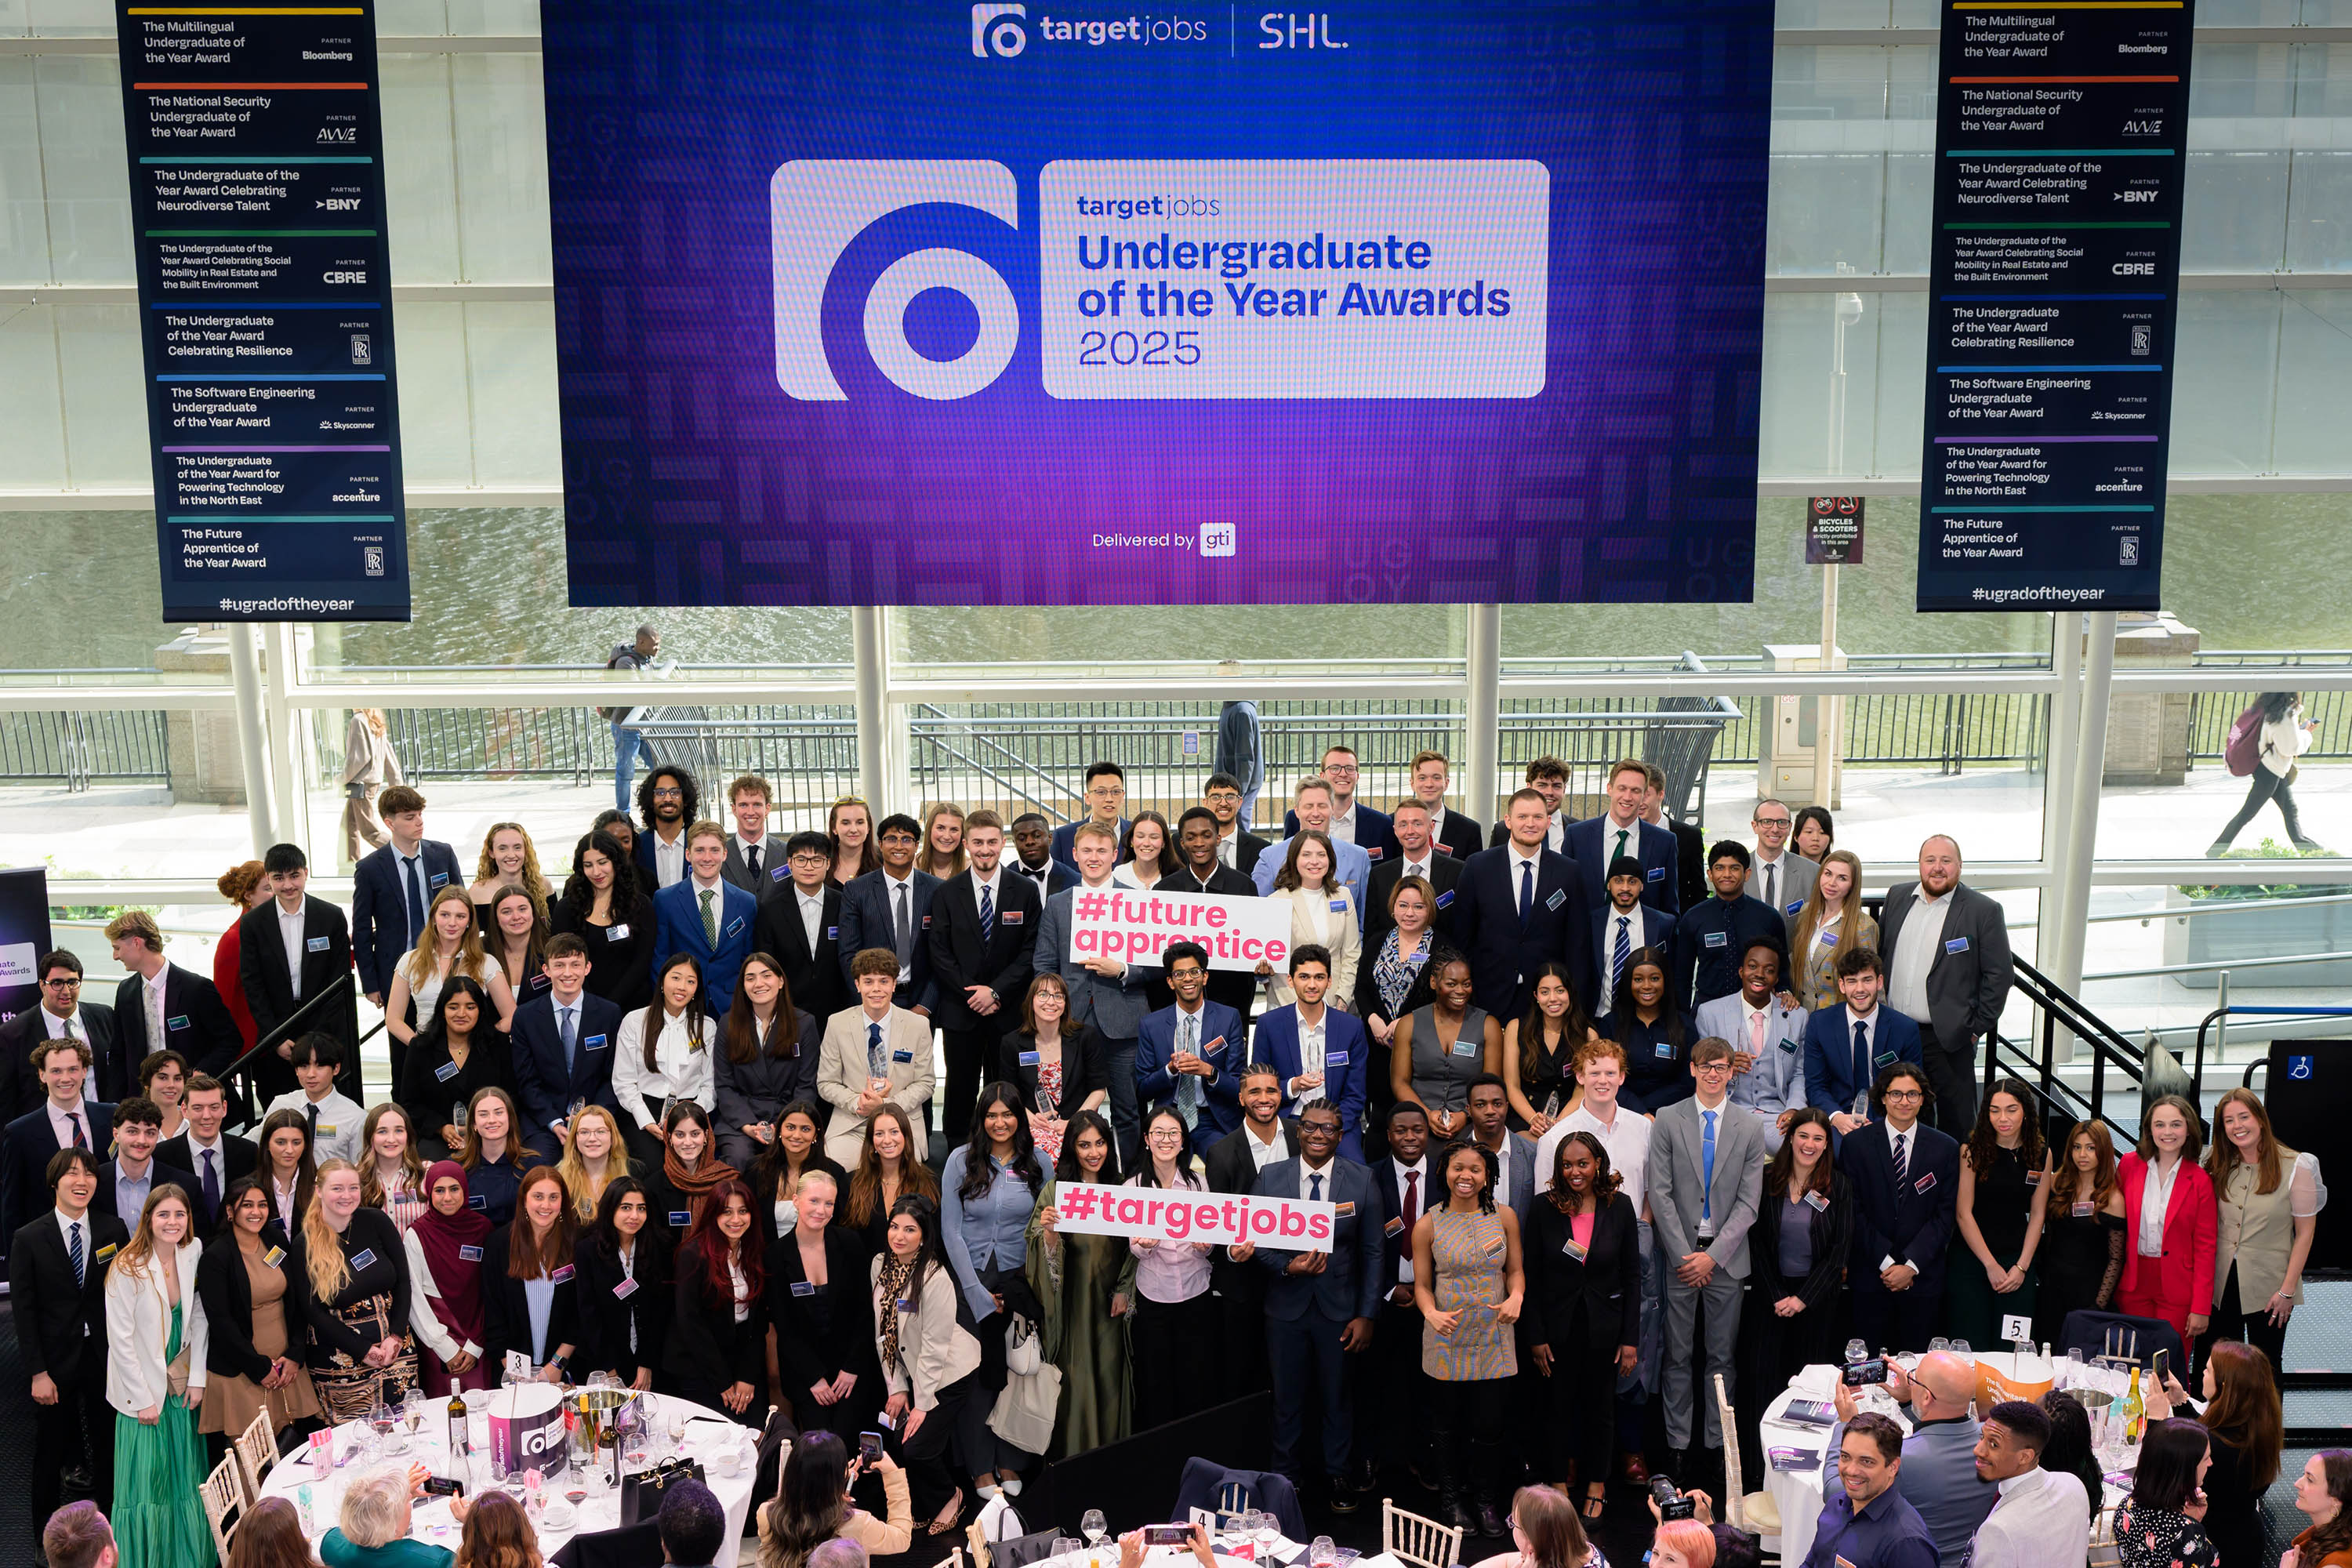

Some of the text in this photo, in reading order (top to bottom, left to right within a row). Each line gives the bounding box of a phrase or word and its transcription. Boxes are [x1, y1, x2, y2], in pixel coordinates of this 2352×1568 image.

[1966, 16, 2055, 27] The Multilingual
[143, 21, 234, 34] The Multilingual
[1040, 14, 1207, 46] targetjobs
[1965, 31, 2064, 43] Undergraduate of
[145, 37, 245, 49] Undergraduate of
[1965, 47, 2047, 56] the Year Award
[2118, 45, 2167, 54] Bloomberg
[146, 53, 230, 63] the Year Award
[303, 51, 352, 61] Bloomberg
[1963, 89, 2082, 101] The National Security
[1962, 104, 2060, 117] Undergraduate of
[1962, 120, 2043, 130] the Year Award
[2122, 121, 2162, 132] AWE
[1959, 162, 2101, 175] The Undergraduate of the
[154, 170, 299, 182] The Undergraduate of the
[1958, 178, 2087, 190] Year Award Celebrating
[156, 185, 286, 198] Year Award Celebrating
[2124, 191, 2158, 201] BNY
[1958, 193, 2069, 203] Neurodiverse Talent
[158, 201, 270, 210] Neurodiverse Talent
[326, 199, 361, 210] BNY
[1076, 195, 1220, 220] targetjobs
[179, 245, 245, 254] Undergraduate
[1077, 232, 1432, 278] Undergraduate
[212, 256, 263, 266] Celebrating
[162, 269, 198, 278] Mobility
[2112, 263, 2154, 274] CBRE
[324, 272, 366, 283] CBRE
[1078, 280, 1511, 317] of the Year Awards
[165, 316, 274, 328] The Undergraduate
[167, 331, 264, 340] of the Year Award
[169, 346, 292, 358] Celebrating Resilience
[1080, 331, 1201, 365] 2025
[1950, 378, 2090, 390] The Software Engineering
[1950, 394, 2032, 405] Undergraduate
[1948, 408, 2043, 418] of the Year Award
[2105, 412, 2146, 421] Skyscanner
[176, 456, 271, 466] The Undergraduate
[178, 470, 188, 478] of
[191, 470, 207, 478] the
[233, 470, 263, 478] Award
[265, 469, 280, 478] for
[179, 483, 284, 494] Powering Technology
[210, 495, 238, 504] North
[332, 492, 379, 502] accenture
[1944, 519, 2002, 528] The Future
[1093, 530, 1230, 550] Delivered by gti
[1943, 533, 2017, 545] Apprentice of
[1943, 547, 2023, 557] the Year Award
[1973, 586, 2104, 602] #ugradoftheyear
[220, 597, 354, 613] #ugradoftheyear
[1076, 892, 1227, 927] #future
[1060, 1186, 1330, 1243] #targetjobs
[2012, 1320, 2021, 1336] 5
[515, 1355, 521, 1369] 3
[1198, 1513, 1206, 1530] 4
